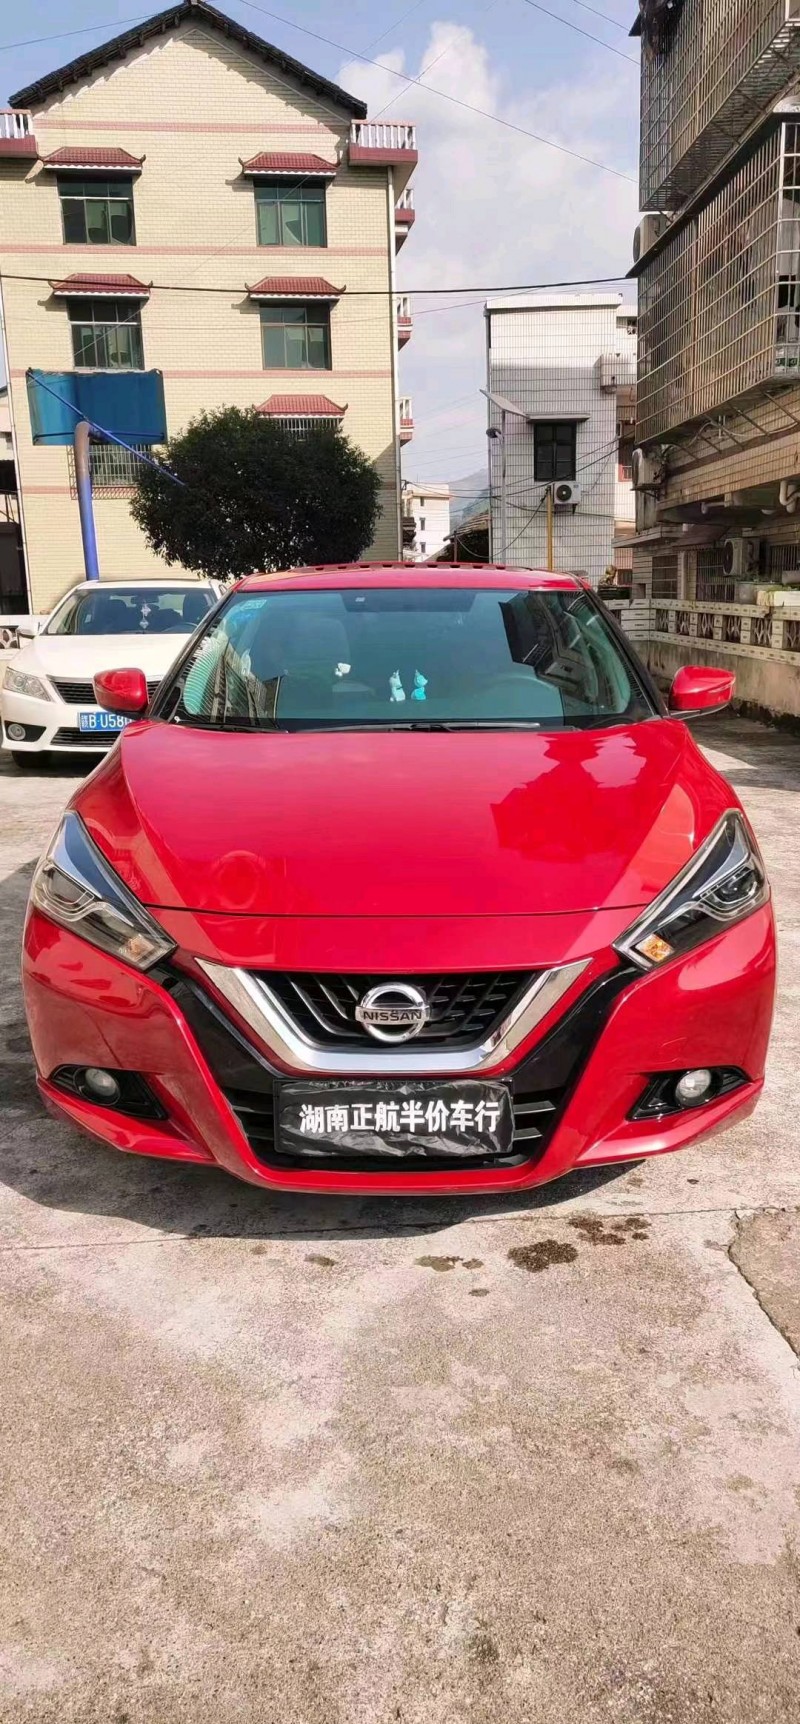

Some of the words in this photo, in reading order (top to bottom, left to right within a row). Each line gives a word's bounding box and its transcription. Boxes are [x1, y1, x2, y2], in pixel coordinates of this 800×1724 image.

[363, 1010, 422, 1021] NISSAN
[299, 1100, 500, 1133] 湖南正航半价车行
